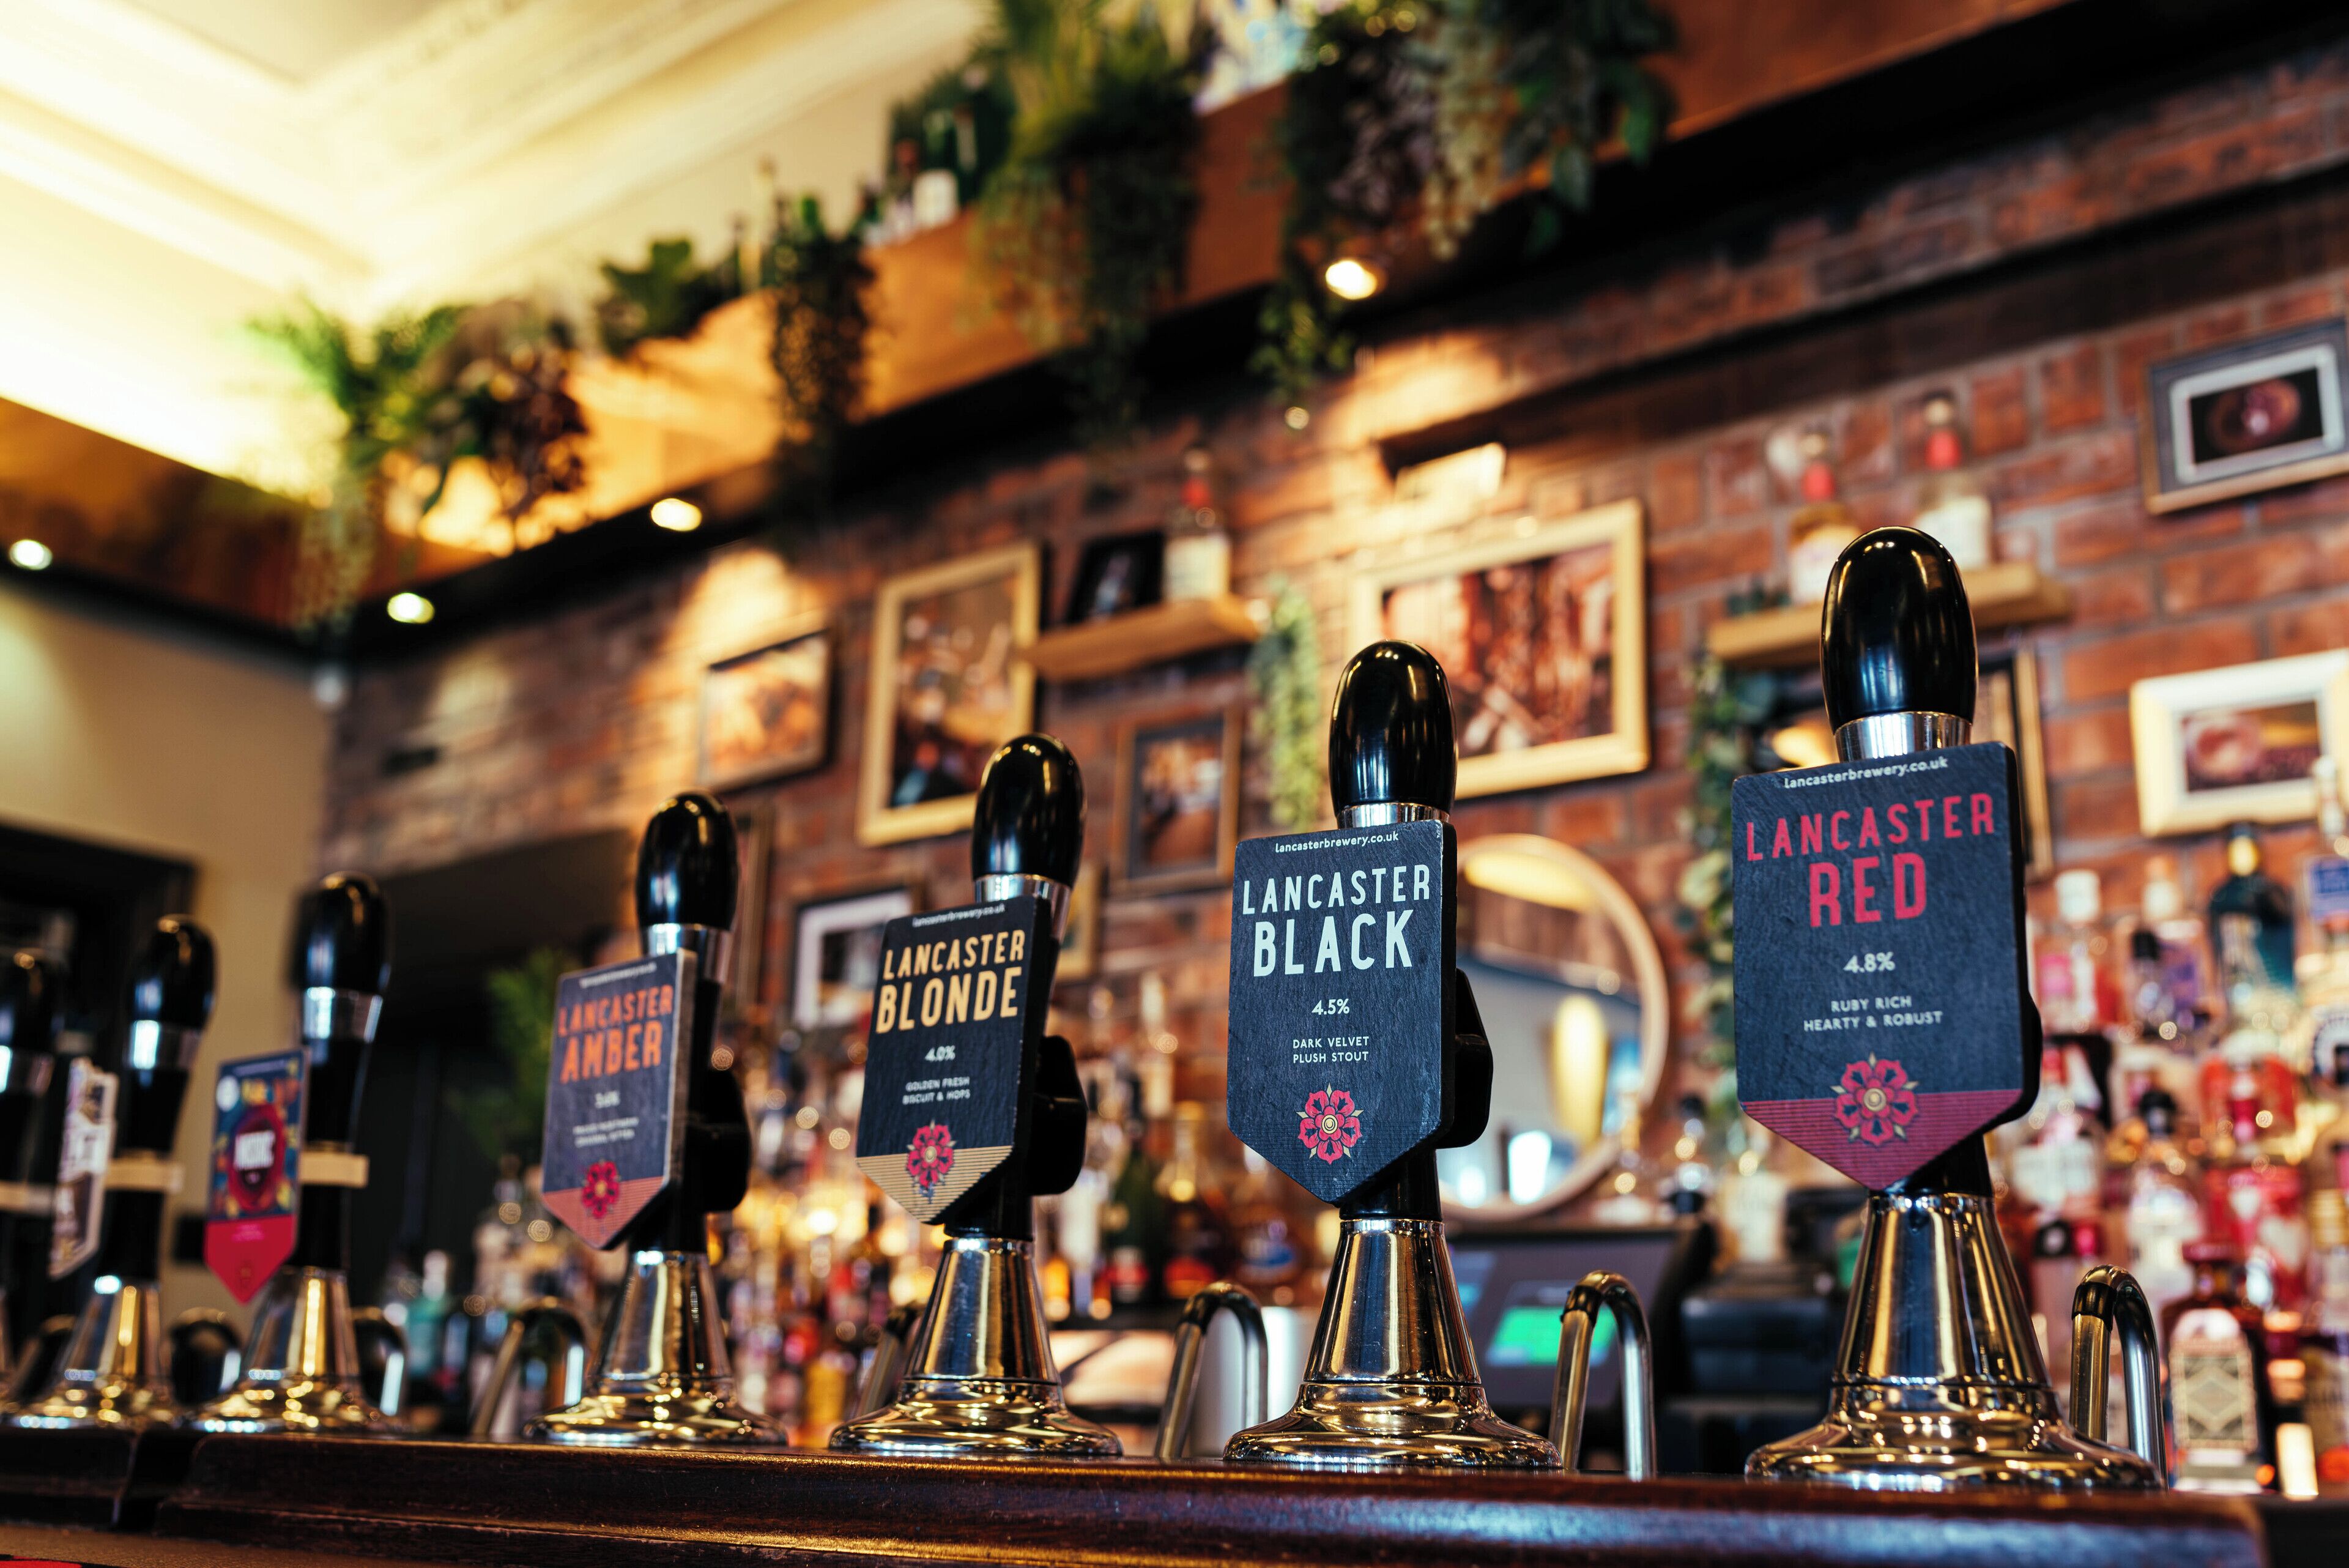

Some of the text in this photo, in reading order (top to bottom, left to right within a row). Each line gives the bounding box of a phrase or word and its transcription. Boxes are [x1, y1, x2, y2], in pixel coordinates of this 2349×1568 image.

[1784, 756, 1948, 789] lancasterbrewery.co.uk
[1275, 831, 1398, 853] lancasterbrewery.co.uk
[1747, 793, 1994, 861] LANCASTER
[1243, 864, 1430, 915] LANCASTER
[1809, 852, 1926, 927] RED
[883, 929, 1025, 980] LANCASTER
[1253, 909, 1413, 977] BLACK
[1843, 951, 1895, 974] 4.8%
[558, 984, 673, 1038] LANCASTER
[876, 967, 1022, 1034] BLONDE
[1311, 998, 1350, 1016] 4.5%
[1831, 996, 1912, 1012] RUBY RICH
[1803, 1011, 1942, 1032] HEARTY & ROBUST
[560, 1020, 662, 1084] AMBER
[925, 1045, 956, 1061] 4.0%
[1293, 1036, 1370, 1049] DARK VELVET
[1293, 1051, 1369, 1064] PLUSH STOUT
